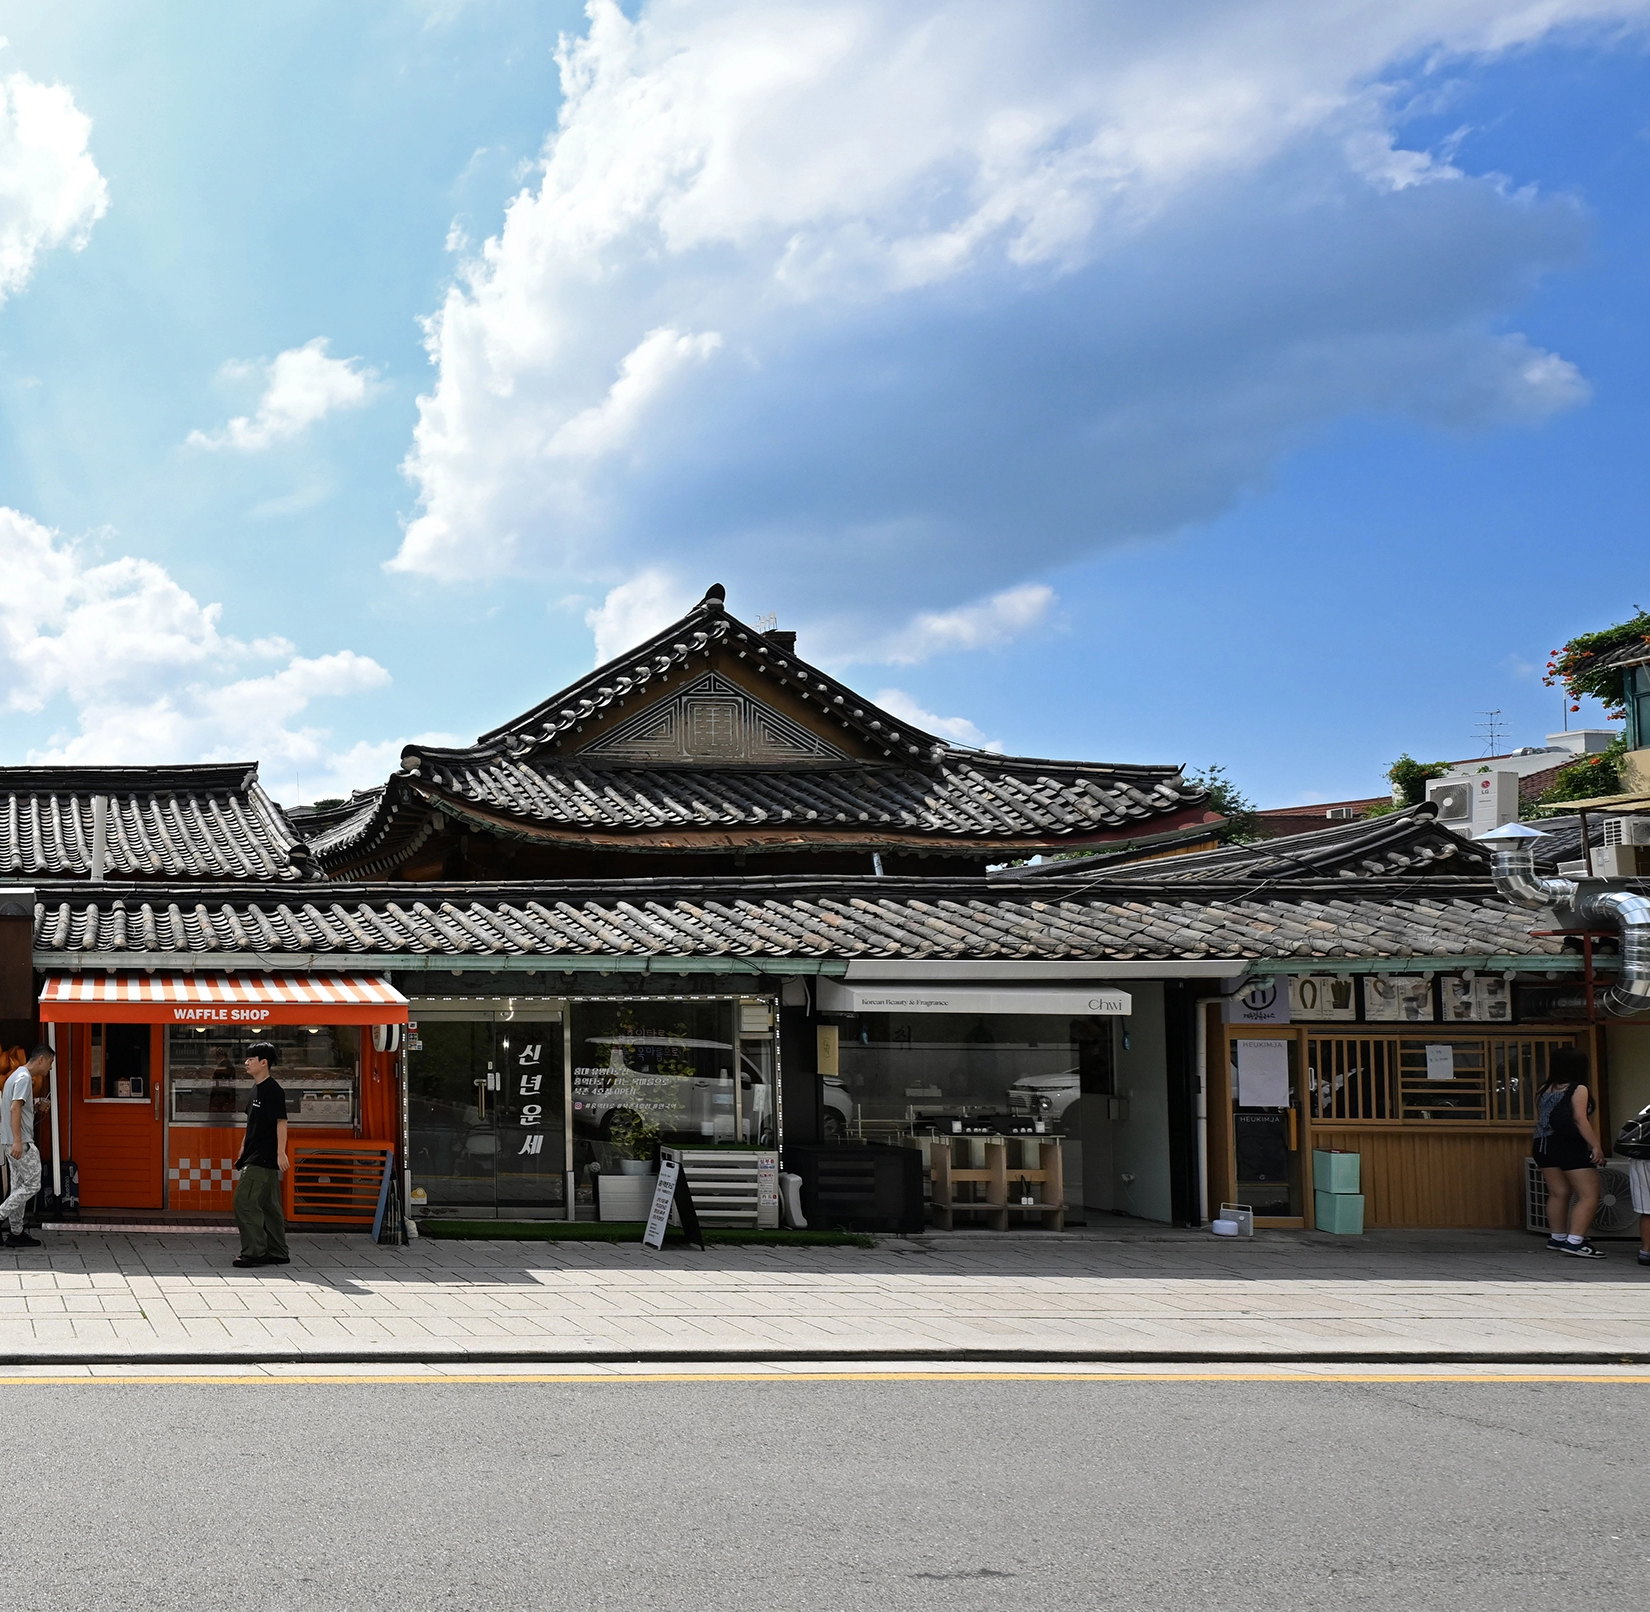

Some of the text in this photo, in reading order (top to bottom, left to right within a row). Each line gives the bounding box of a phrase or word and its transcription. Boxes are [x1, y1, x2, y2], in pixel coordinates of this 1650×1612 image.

[861, 998, 949, 1008] Korean Beauty & Fragrance
[1088, 998, 1122, 1011] Chwi
[173, 1009, 270, 1020] WAFFLE SHOP
[614, 1087, 636, 1095] OPEN
[517, 1044, 545, 1156] 신년운세
